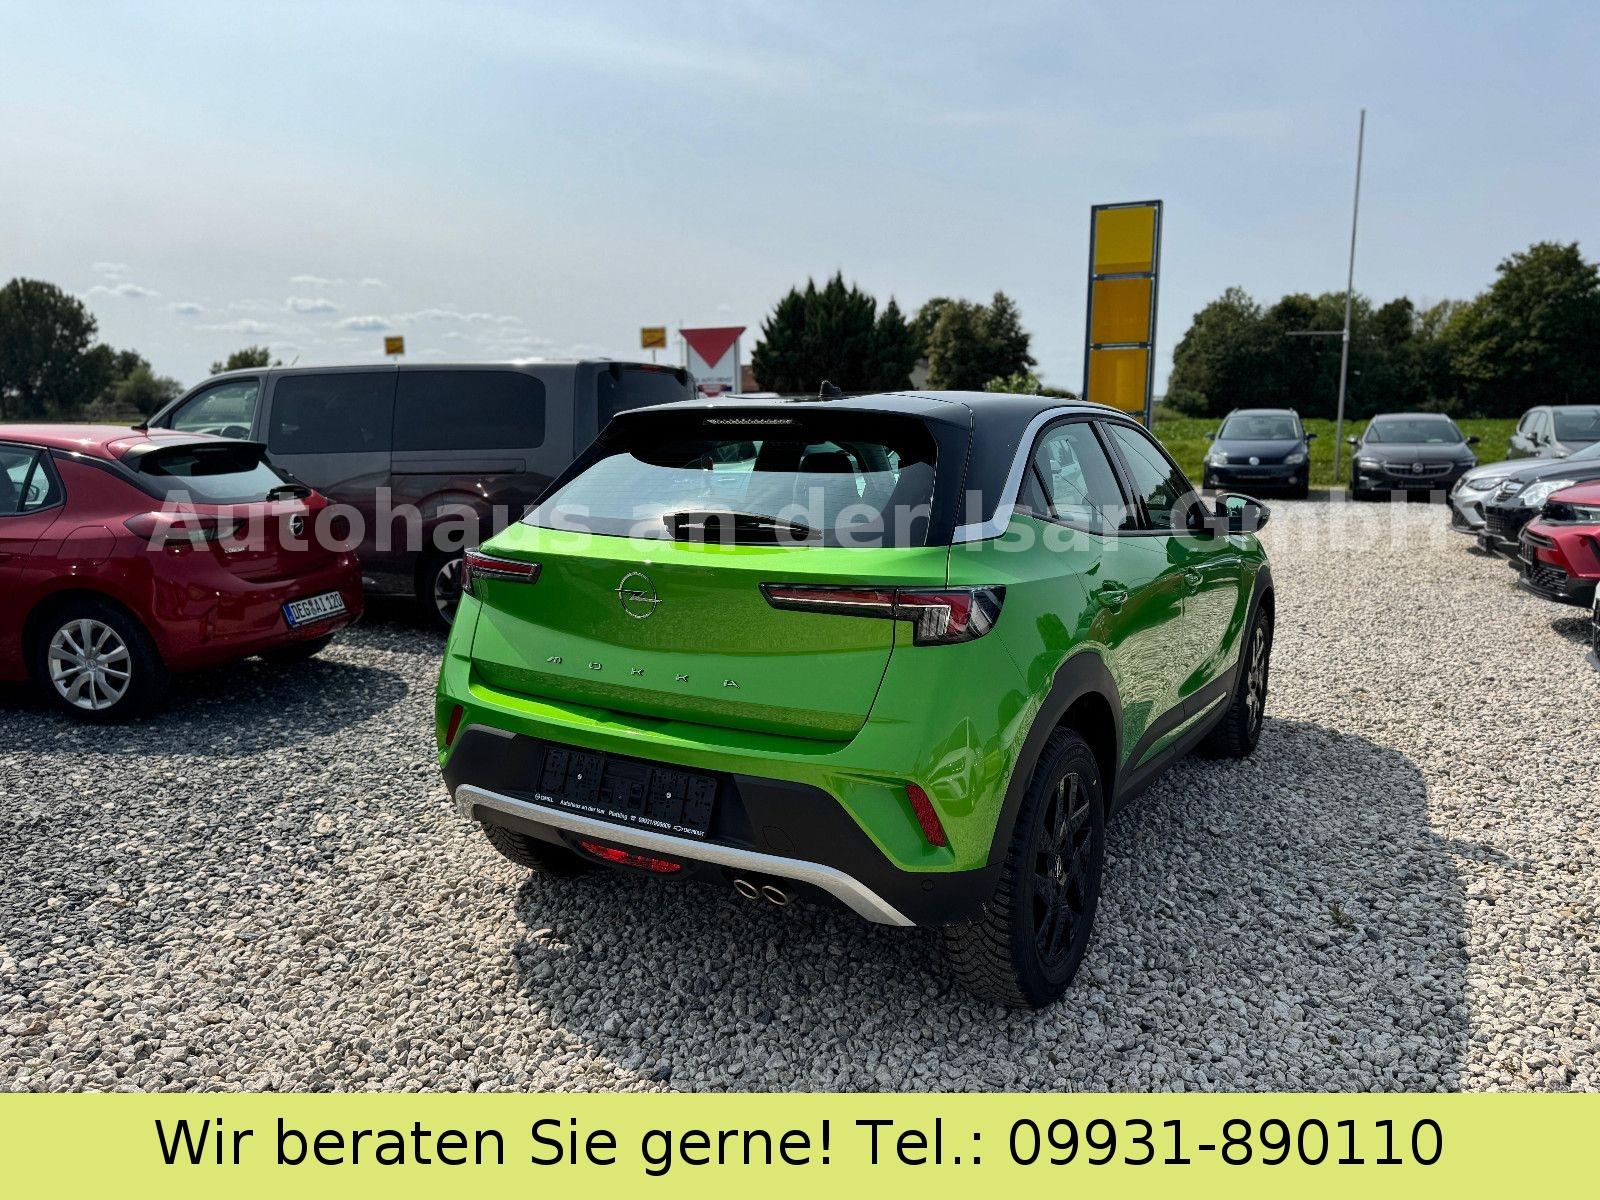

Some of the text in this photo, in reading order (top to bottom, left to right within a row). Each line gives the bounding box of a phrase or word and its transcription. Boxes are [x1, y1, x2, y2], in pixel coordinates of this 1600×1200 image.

[291, 593, 343, 620] DEG AI 120
[546, 655, 741, 689] MOKKA
